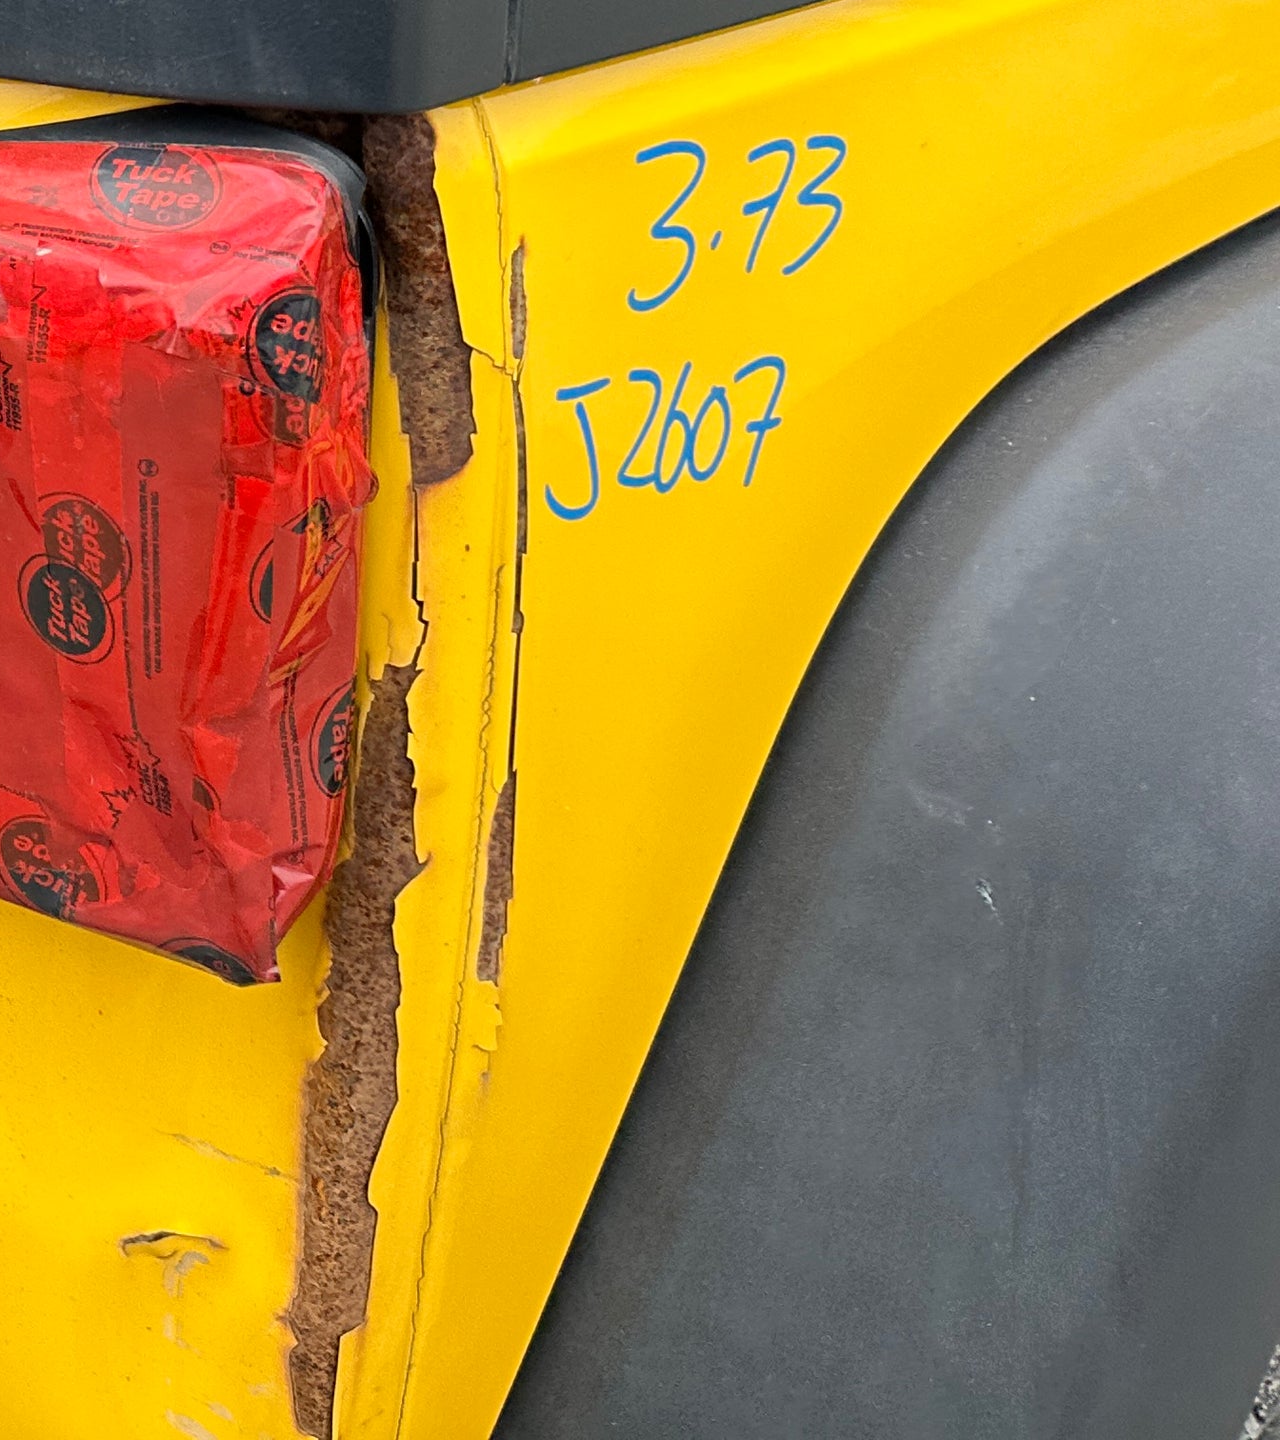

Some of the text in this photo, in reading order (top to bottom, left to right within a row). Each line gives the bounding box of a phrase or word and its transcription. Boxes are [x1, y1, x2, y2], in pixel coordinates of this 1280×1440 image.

[112, 158, 197, 185] Tuck
[115, 181, 202, 210] Tape
[627, 135, 846, 312] 3.73
[544, 355, 787, 521] J2607
[44, 572, 67, 641] Tuck
